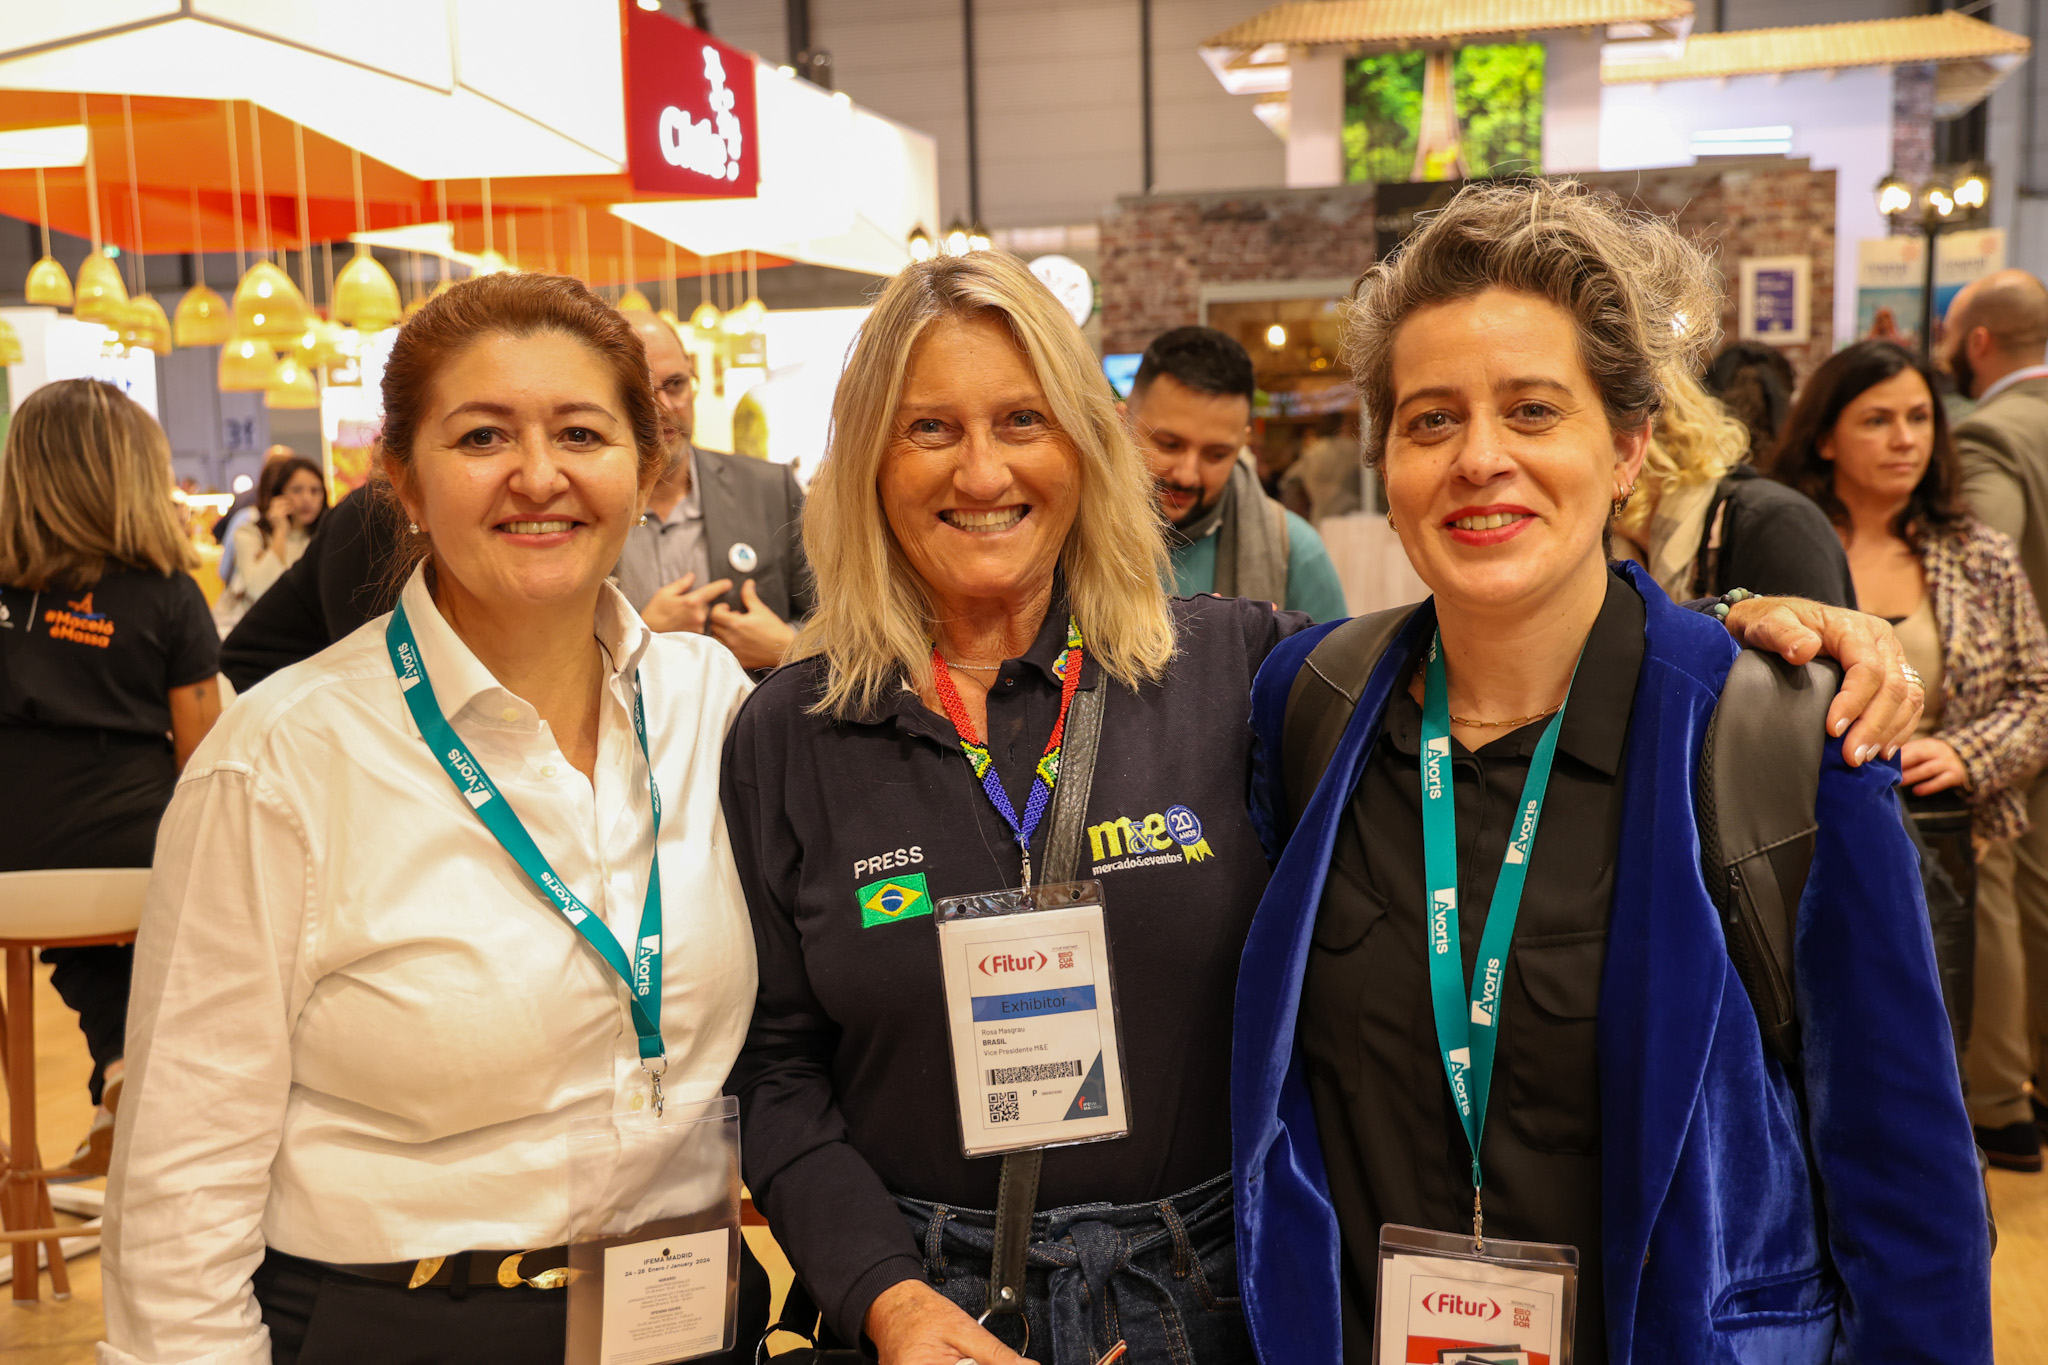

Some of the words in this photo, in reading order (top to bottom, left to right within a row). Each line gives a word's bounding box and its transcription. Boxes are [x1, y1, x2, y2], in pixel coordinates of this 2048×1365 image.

[1170, 811, 1193, 832] 20
[853, 846, 924, 879] PRESS
[1092, 853, 1183, 876] mercado&eventos
[1001, 996, 1068, 1014] Exhibitor
[998, 1027, 1025, 1035] Masgrau
[982, 1038, 1007, 1046] BRASIL
[998, 1045, 1033, 1055] Presidente
[1034, 1043, 1049, 1052] M&E
[643, 1257, 665, 1265] IFEMA
[666, 1252, 693, 1261] MADRID
[648, 1265, 665, 1273] Enero
[671, 1261, 693, 1269] January
[695, 1257, 711, 1265] 2024
